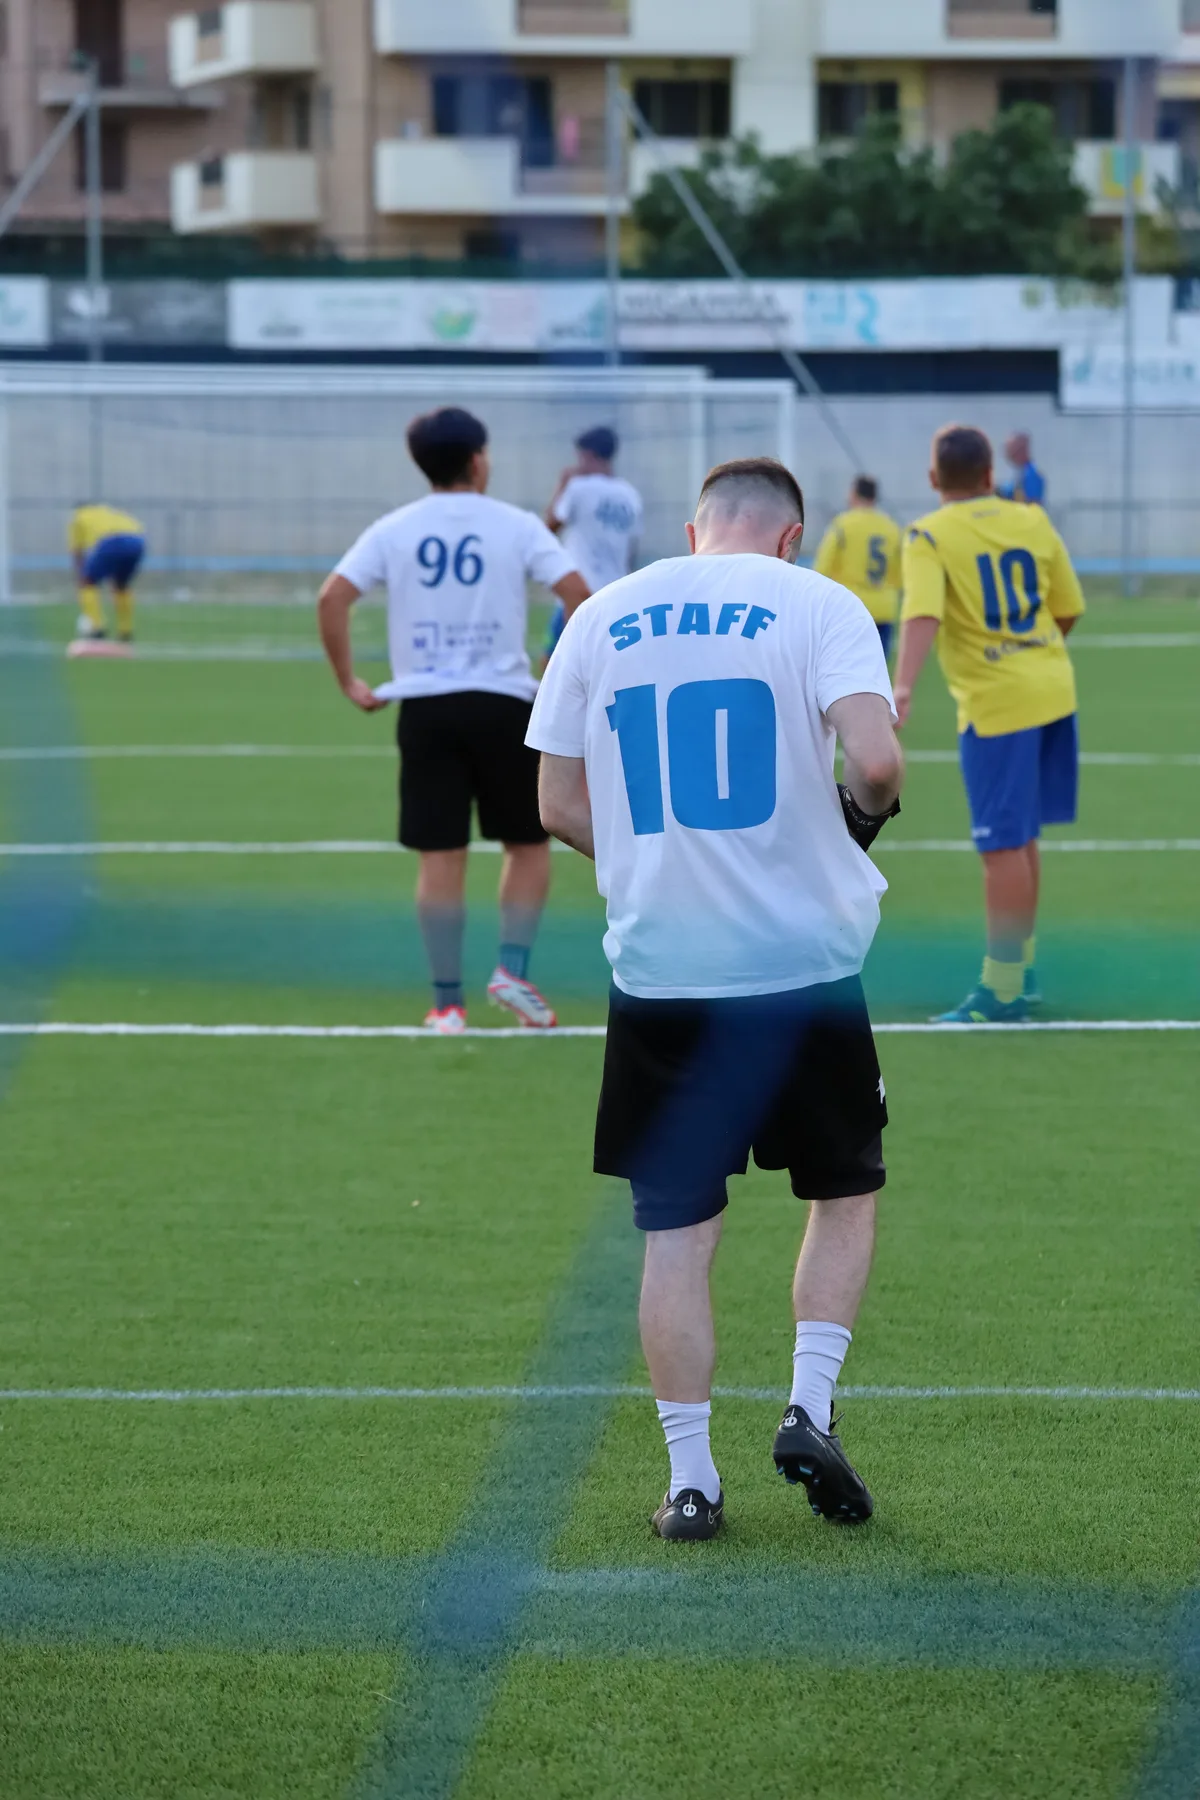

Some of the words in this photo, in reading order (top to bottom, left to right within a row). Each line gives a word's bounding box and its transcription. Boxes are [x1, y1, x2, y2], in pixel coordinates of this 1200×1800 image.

[417, 534, 484, 589] 96
[867, 535, 888, 585] 5
[976, 547, 1042, 635] 10
[609, 602, 778, 652] STAFF
[605, 678, 777, 836] 10
